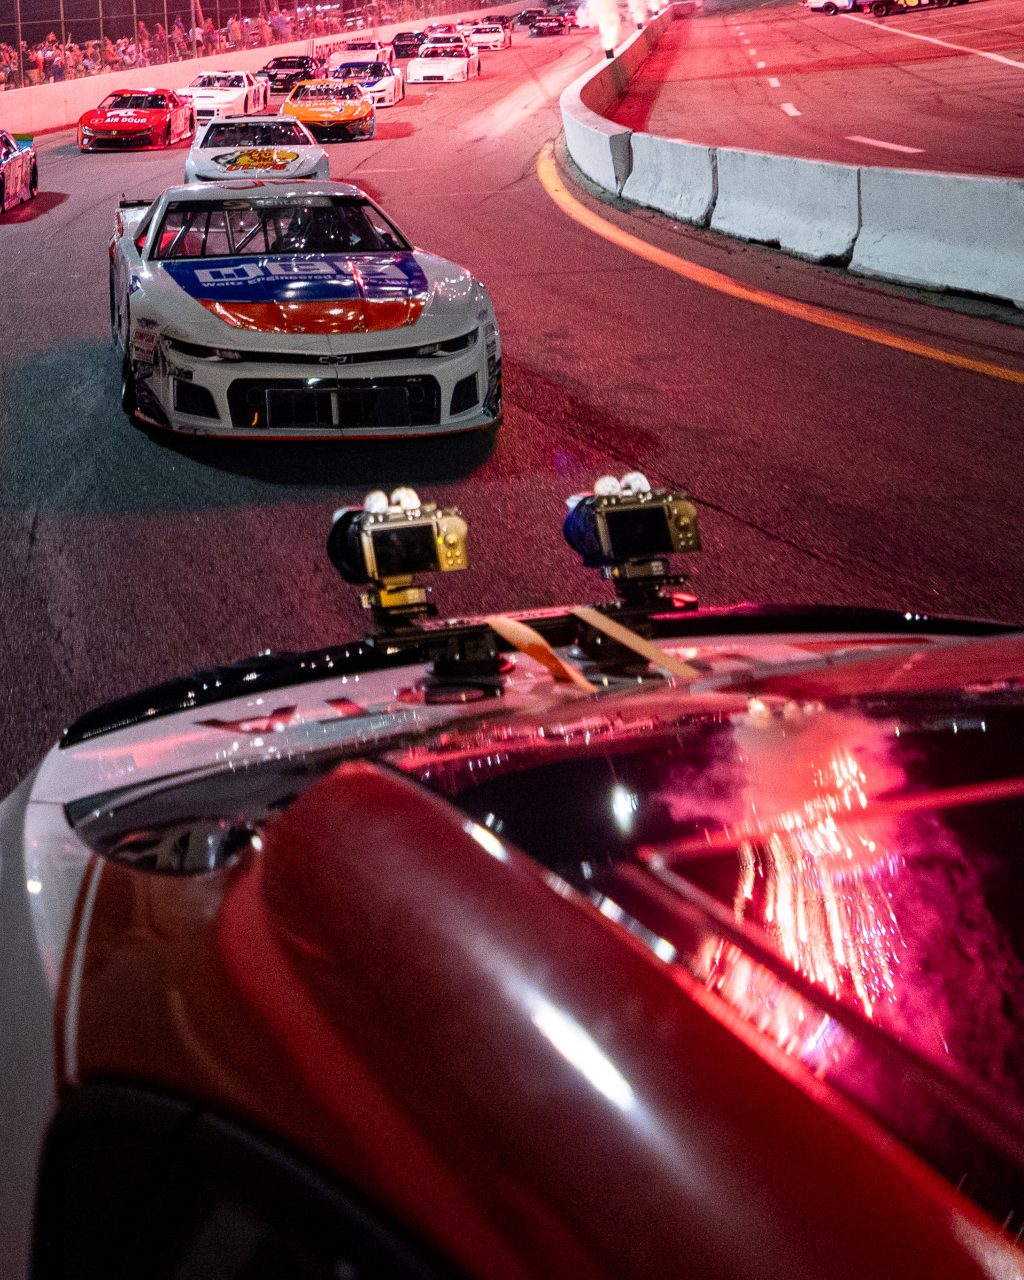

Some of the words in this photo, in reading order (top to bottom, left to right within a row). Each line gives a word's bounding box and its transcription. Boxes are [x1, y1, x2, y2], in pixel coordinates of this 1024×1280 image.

[121, 117, 148, 125] DOUG
[202, 278, 243, 288] Waltz
[247, 274, 333, 286] Engineered
